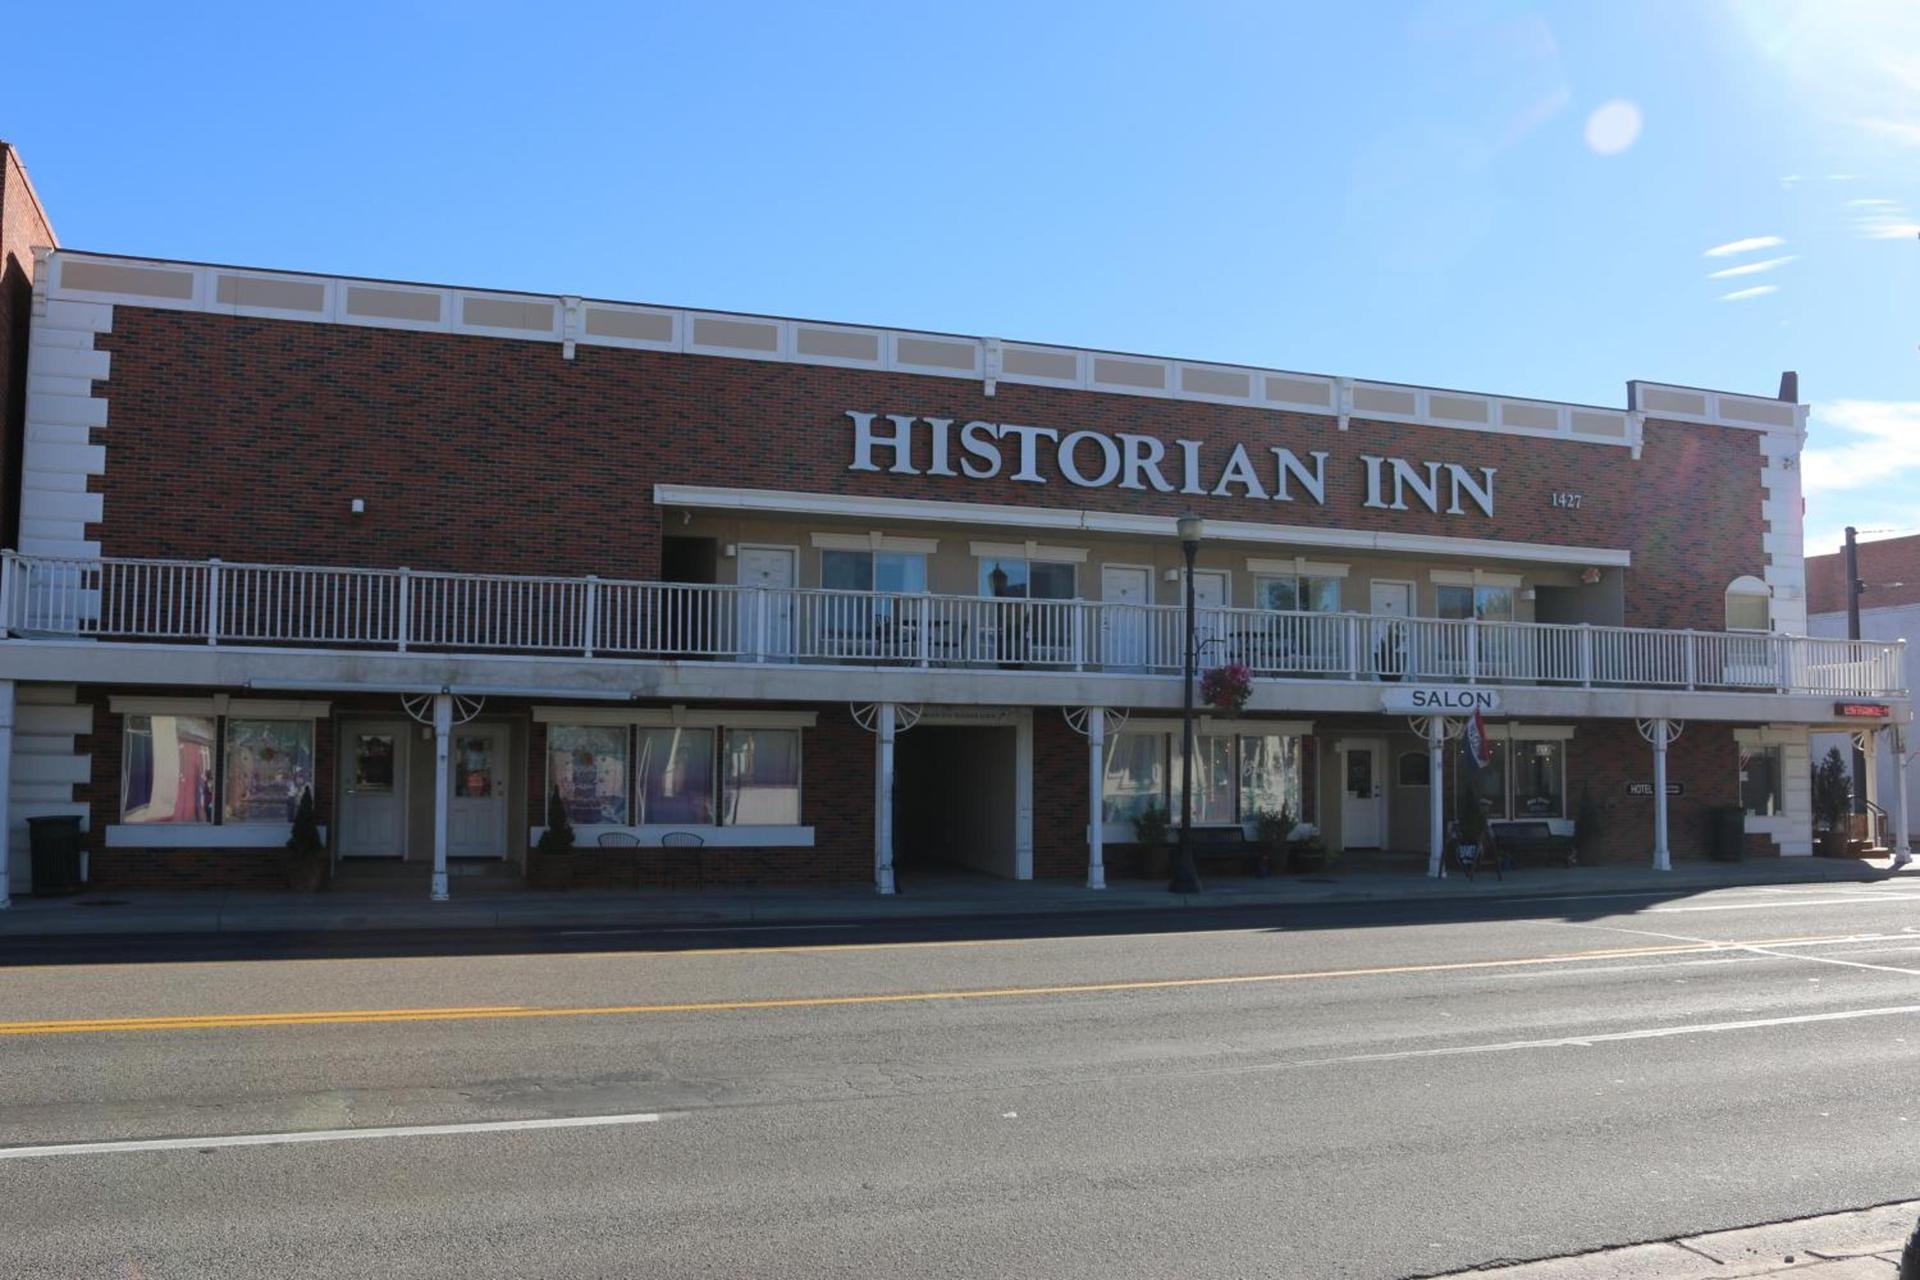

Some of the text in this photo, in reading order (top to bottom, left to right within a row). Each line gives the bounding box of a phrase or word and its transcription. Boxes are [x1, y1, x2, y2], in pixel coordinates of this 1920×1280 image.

[845, 410, 1497, 518] HISTORIAN INN
[1552, 492, 1582, 509] 1427
[1412, 690, 1492, 708] SALON
[1630, 783, 1653, 794] HOTEL
